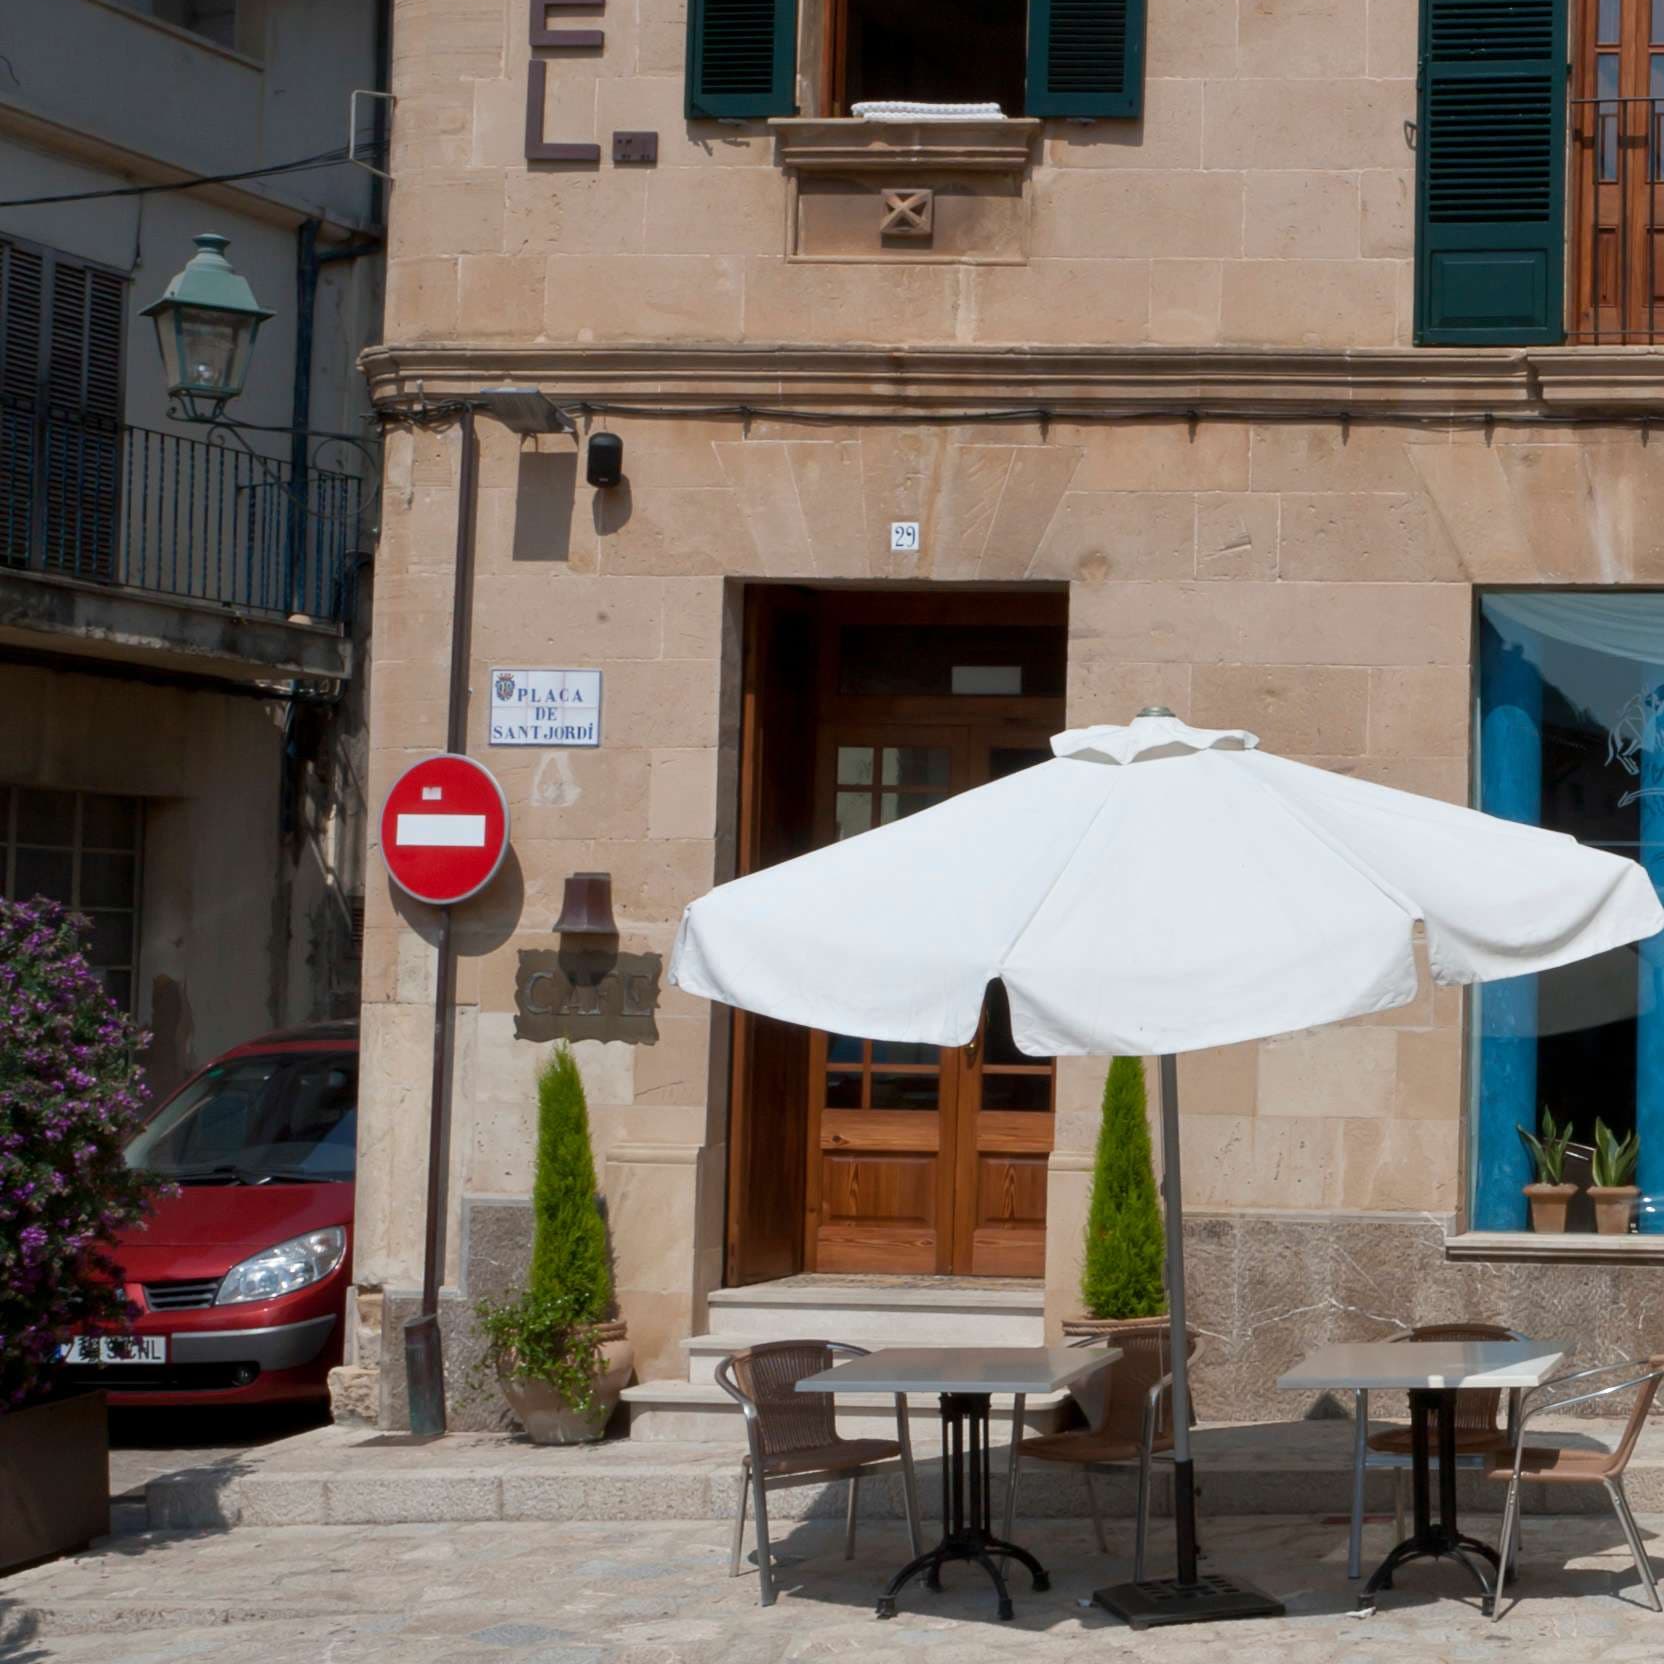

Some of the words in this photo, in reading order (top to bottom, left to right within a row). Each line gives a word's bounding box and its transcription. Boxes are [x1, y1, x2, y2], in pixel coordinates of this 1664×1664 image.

[894, 525, 916, 548] 29
[535, 706, 557, 721] DE
[493, 726, 541, 739] SANT
